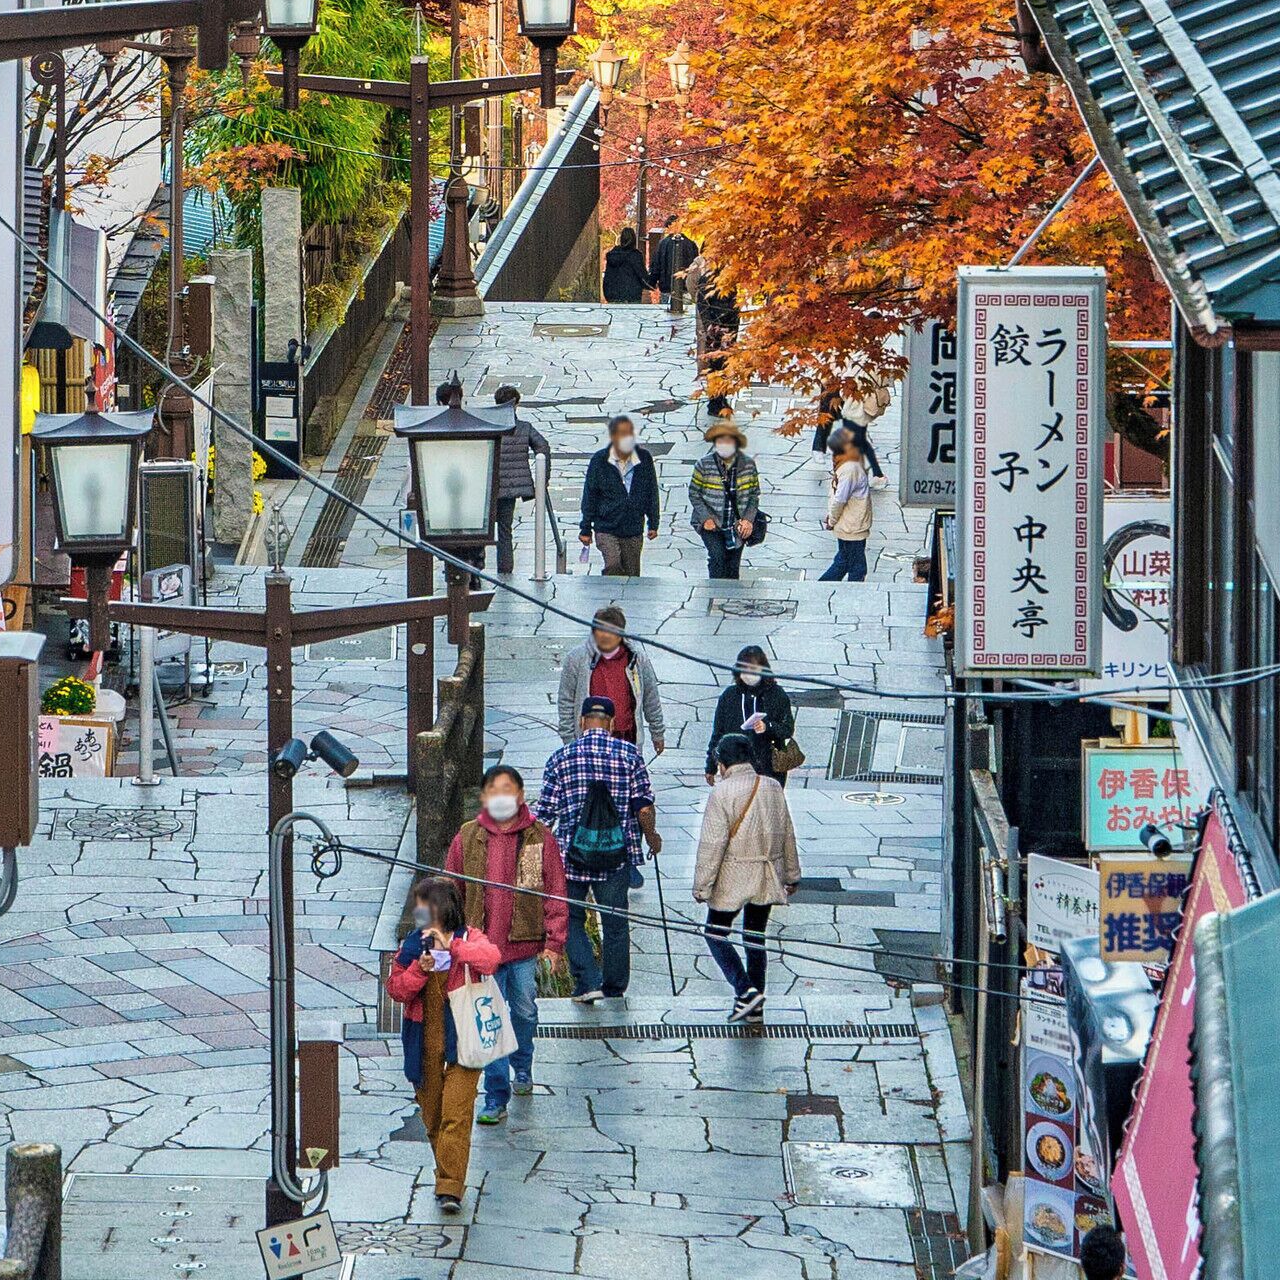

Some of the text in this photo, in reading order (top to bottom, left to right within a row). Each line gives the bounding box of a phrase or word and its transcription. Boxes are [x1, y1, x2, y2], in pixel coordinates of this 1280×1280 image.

[989, 323, 1031, 493] 餃子
[1034, 327, 1069, 492] ラーメン
[1010, 514, 1049, 639] 中央亭
[1097, 768, 1191, 800] 伊香保
